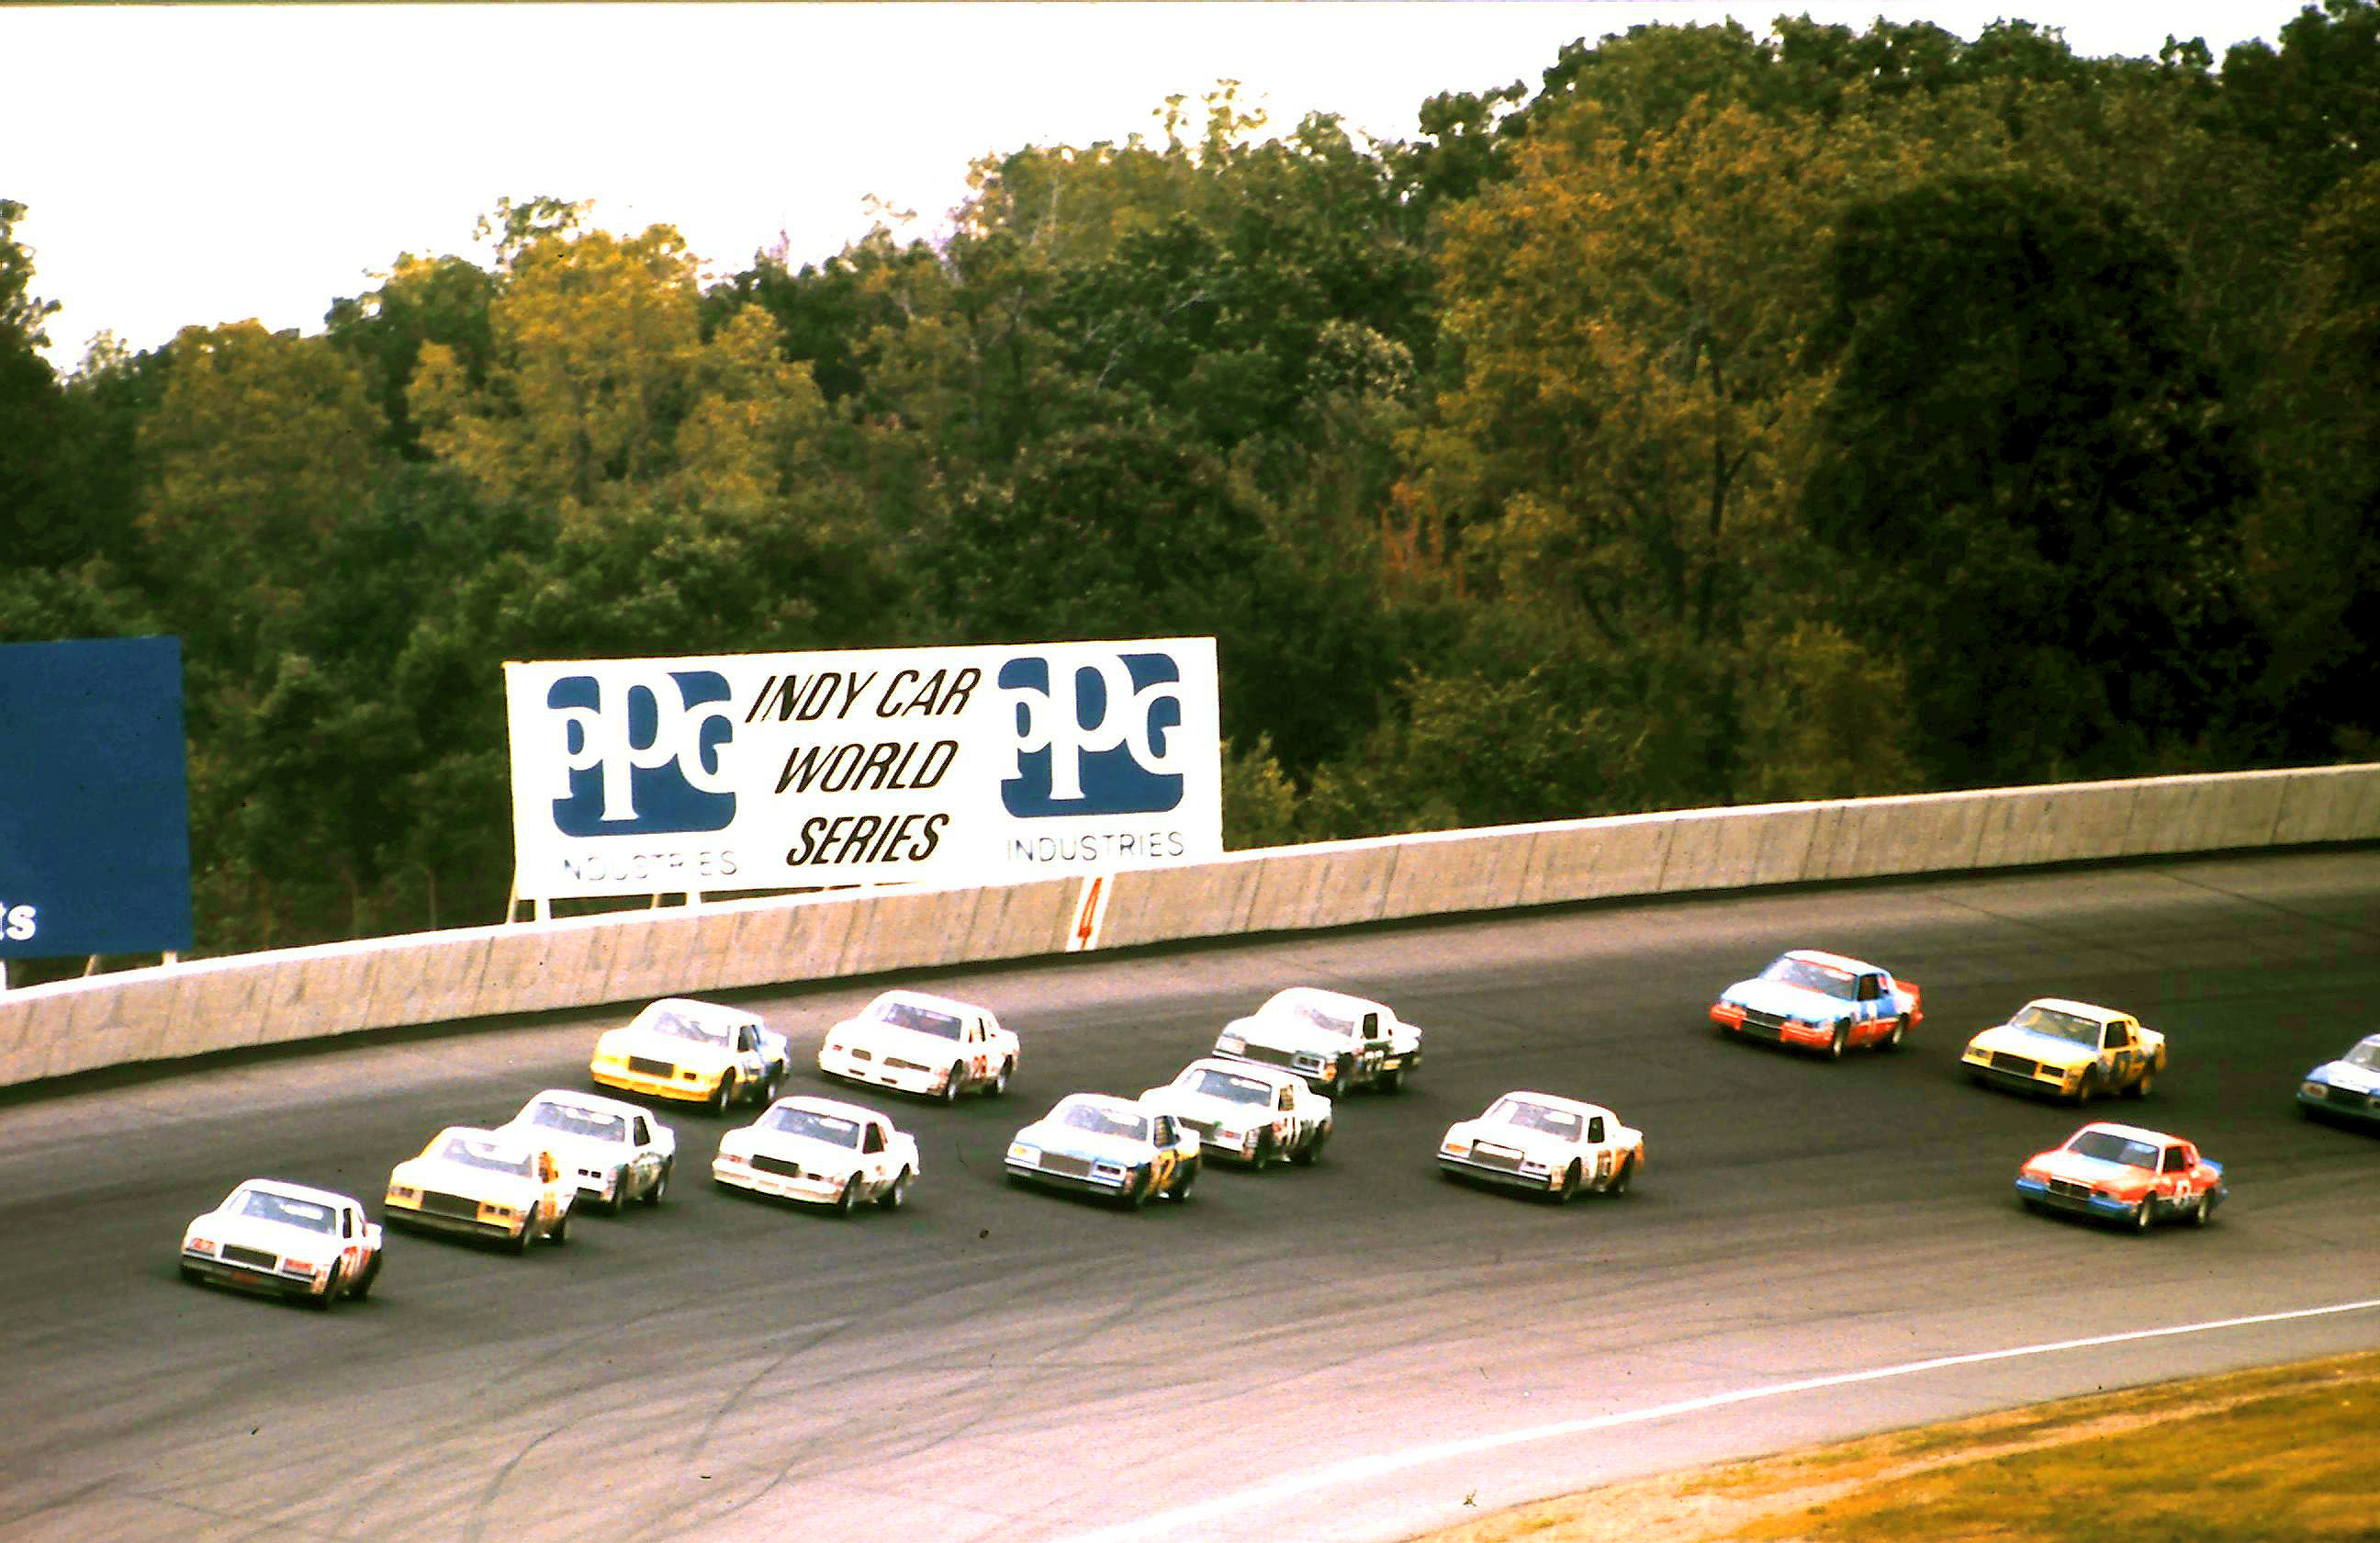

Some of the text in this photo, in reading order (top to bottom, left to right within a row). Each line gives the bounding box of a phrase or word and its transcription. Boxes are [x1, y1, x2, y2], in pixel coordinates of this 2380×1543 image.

[745, 668, 982, 723] INDY CAR
[774, 740, 960, 794] WORLD
[786, 813, 950, 866] SERIES
[1007, 830, 1184, 862] INDUSTRIES
